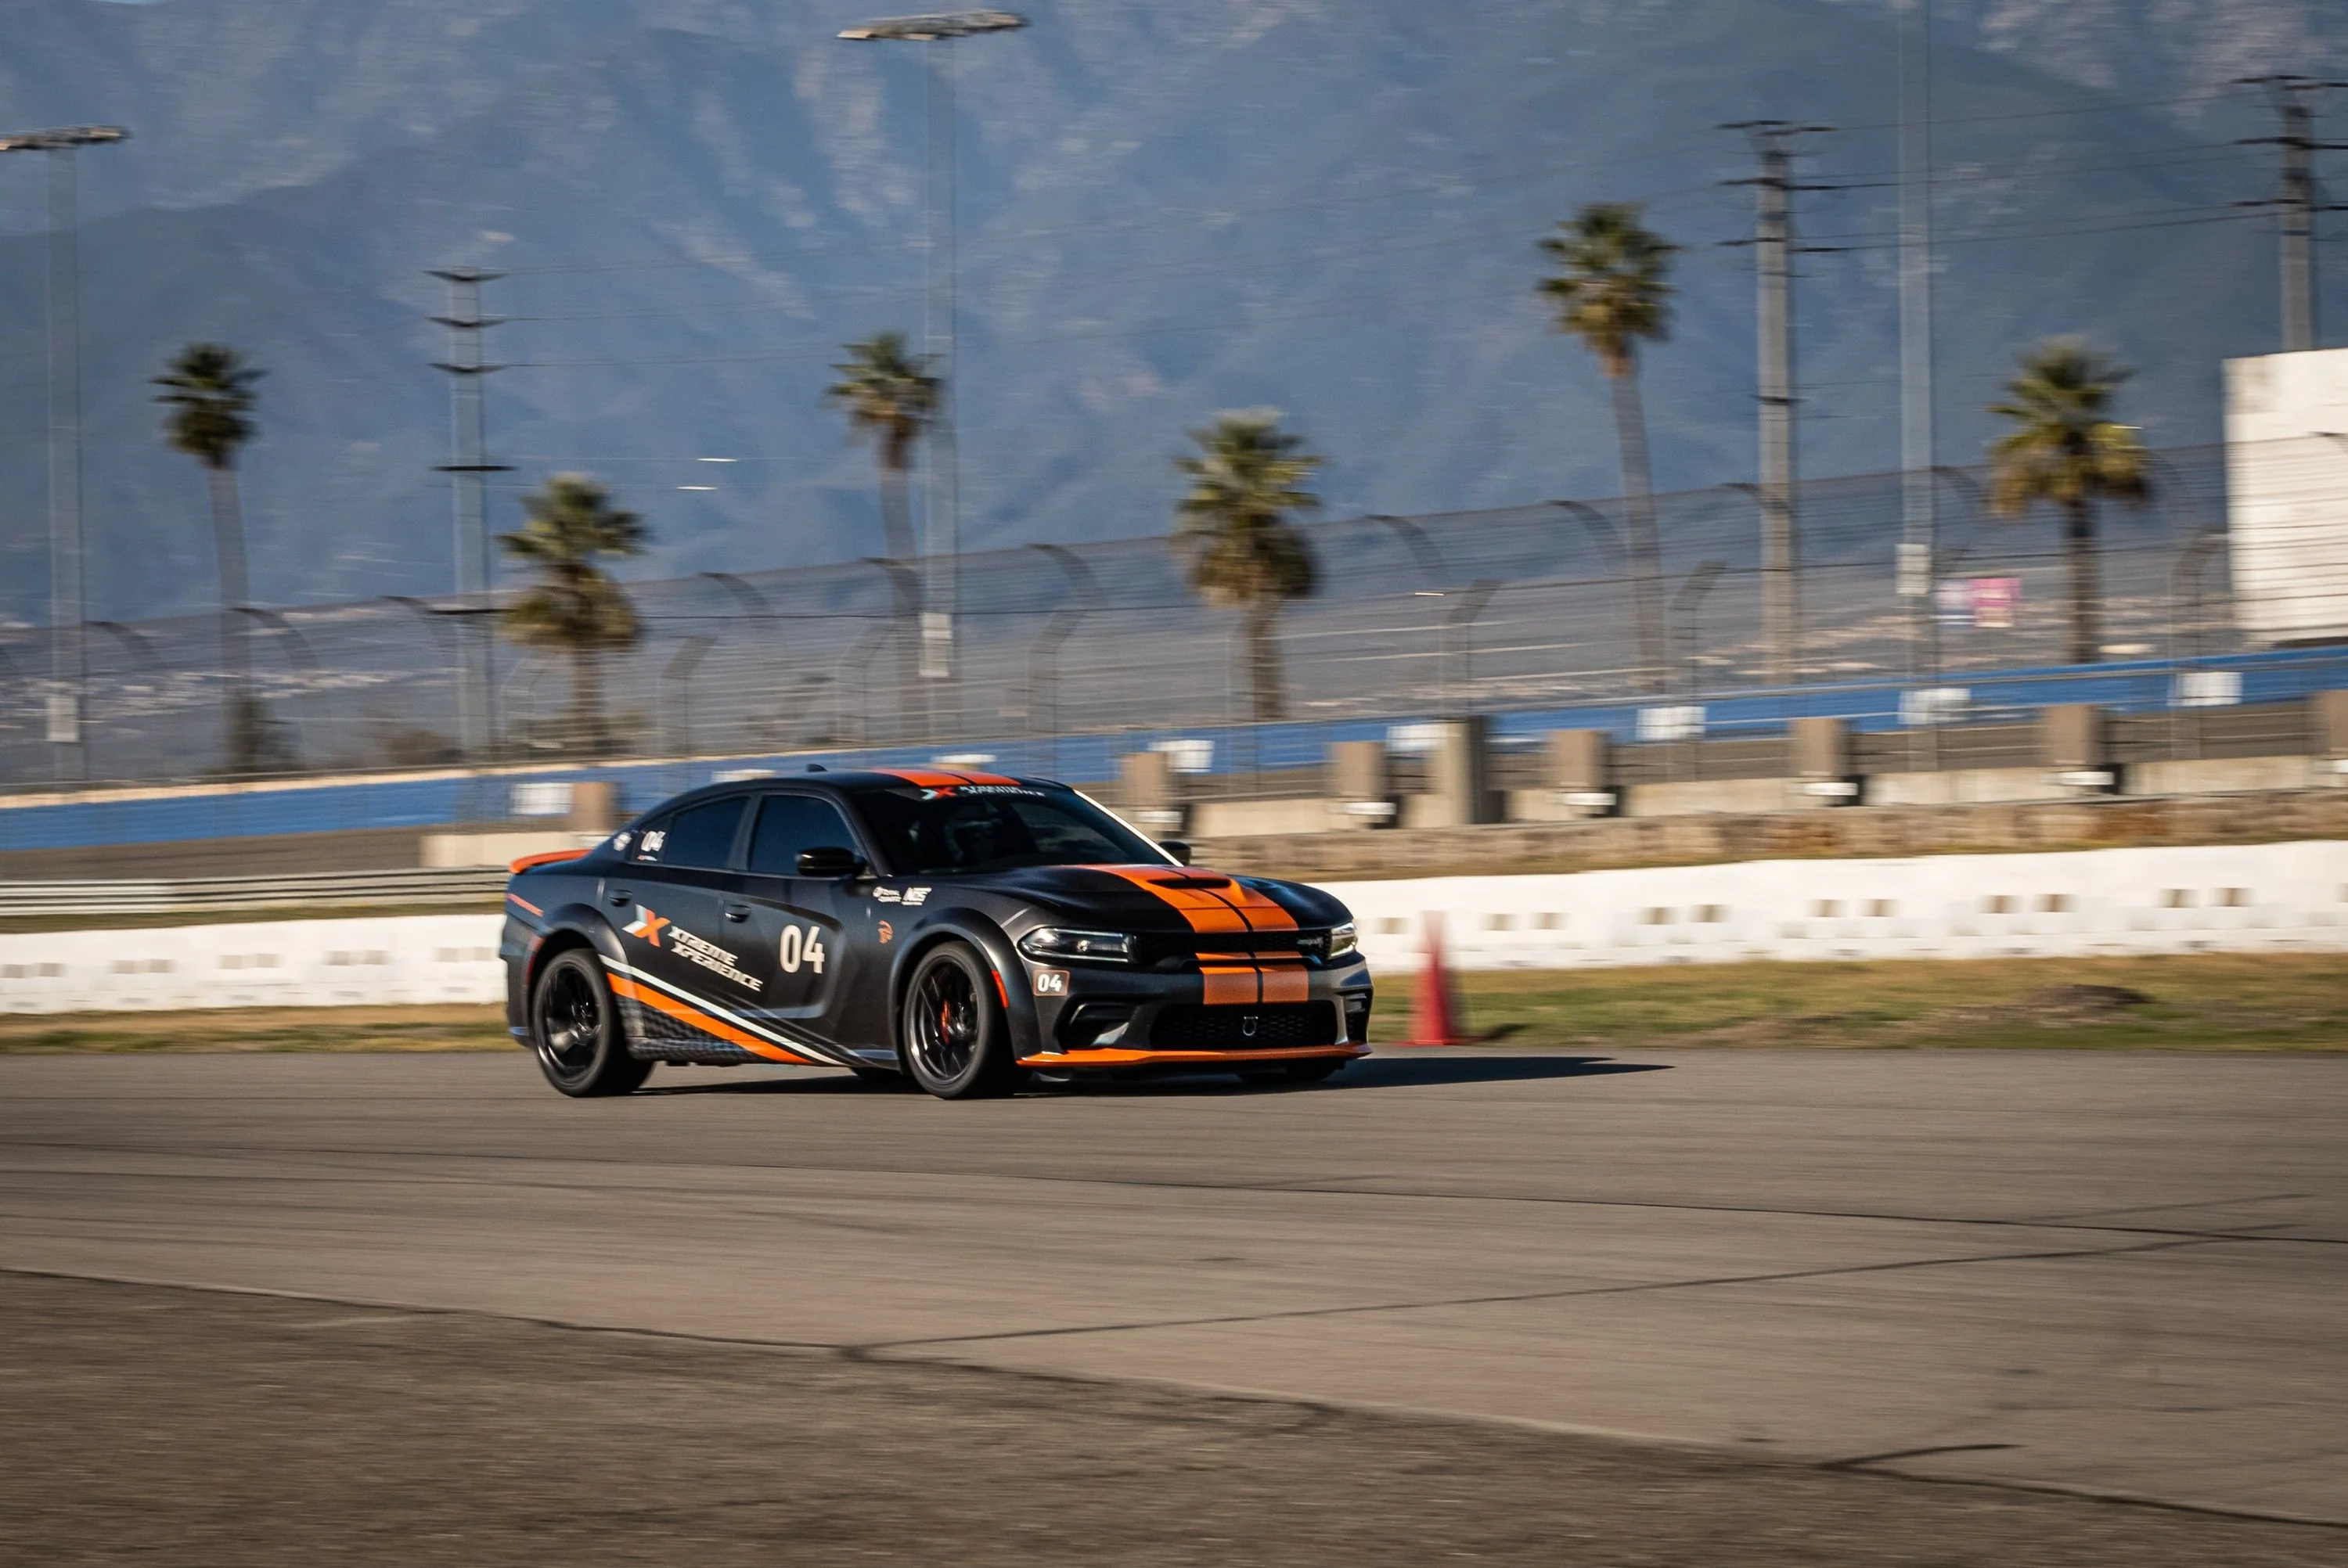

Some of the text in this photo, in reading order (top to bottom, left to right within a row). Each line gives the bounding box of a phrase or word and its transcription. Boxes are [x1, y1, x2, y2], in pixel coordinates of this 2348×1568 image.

[641, 831, 666, 852] 04
[667, 925, 739, 967] XTREME
[670, 940, 764, 993] XPERIENCE
[780, 924, 826, 974] 04
[1037, 973, 1062, 992] 04
